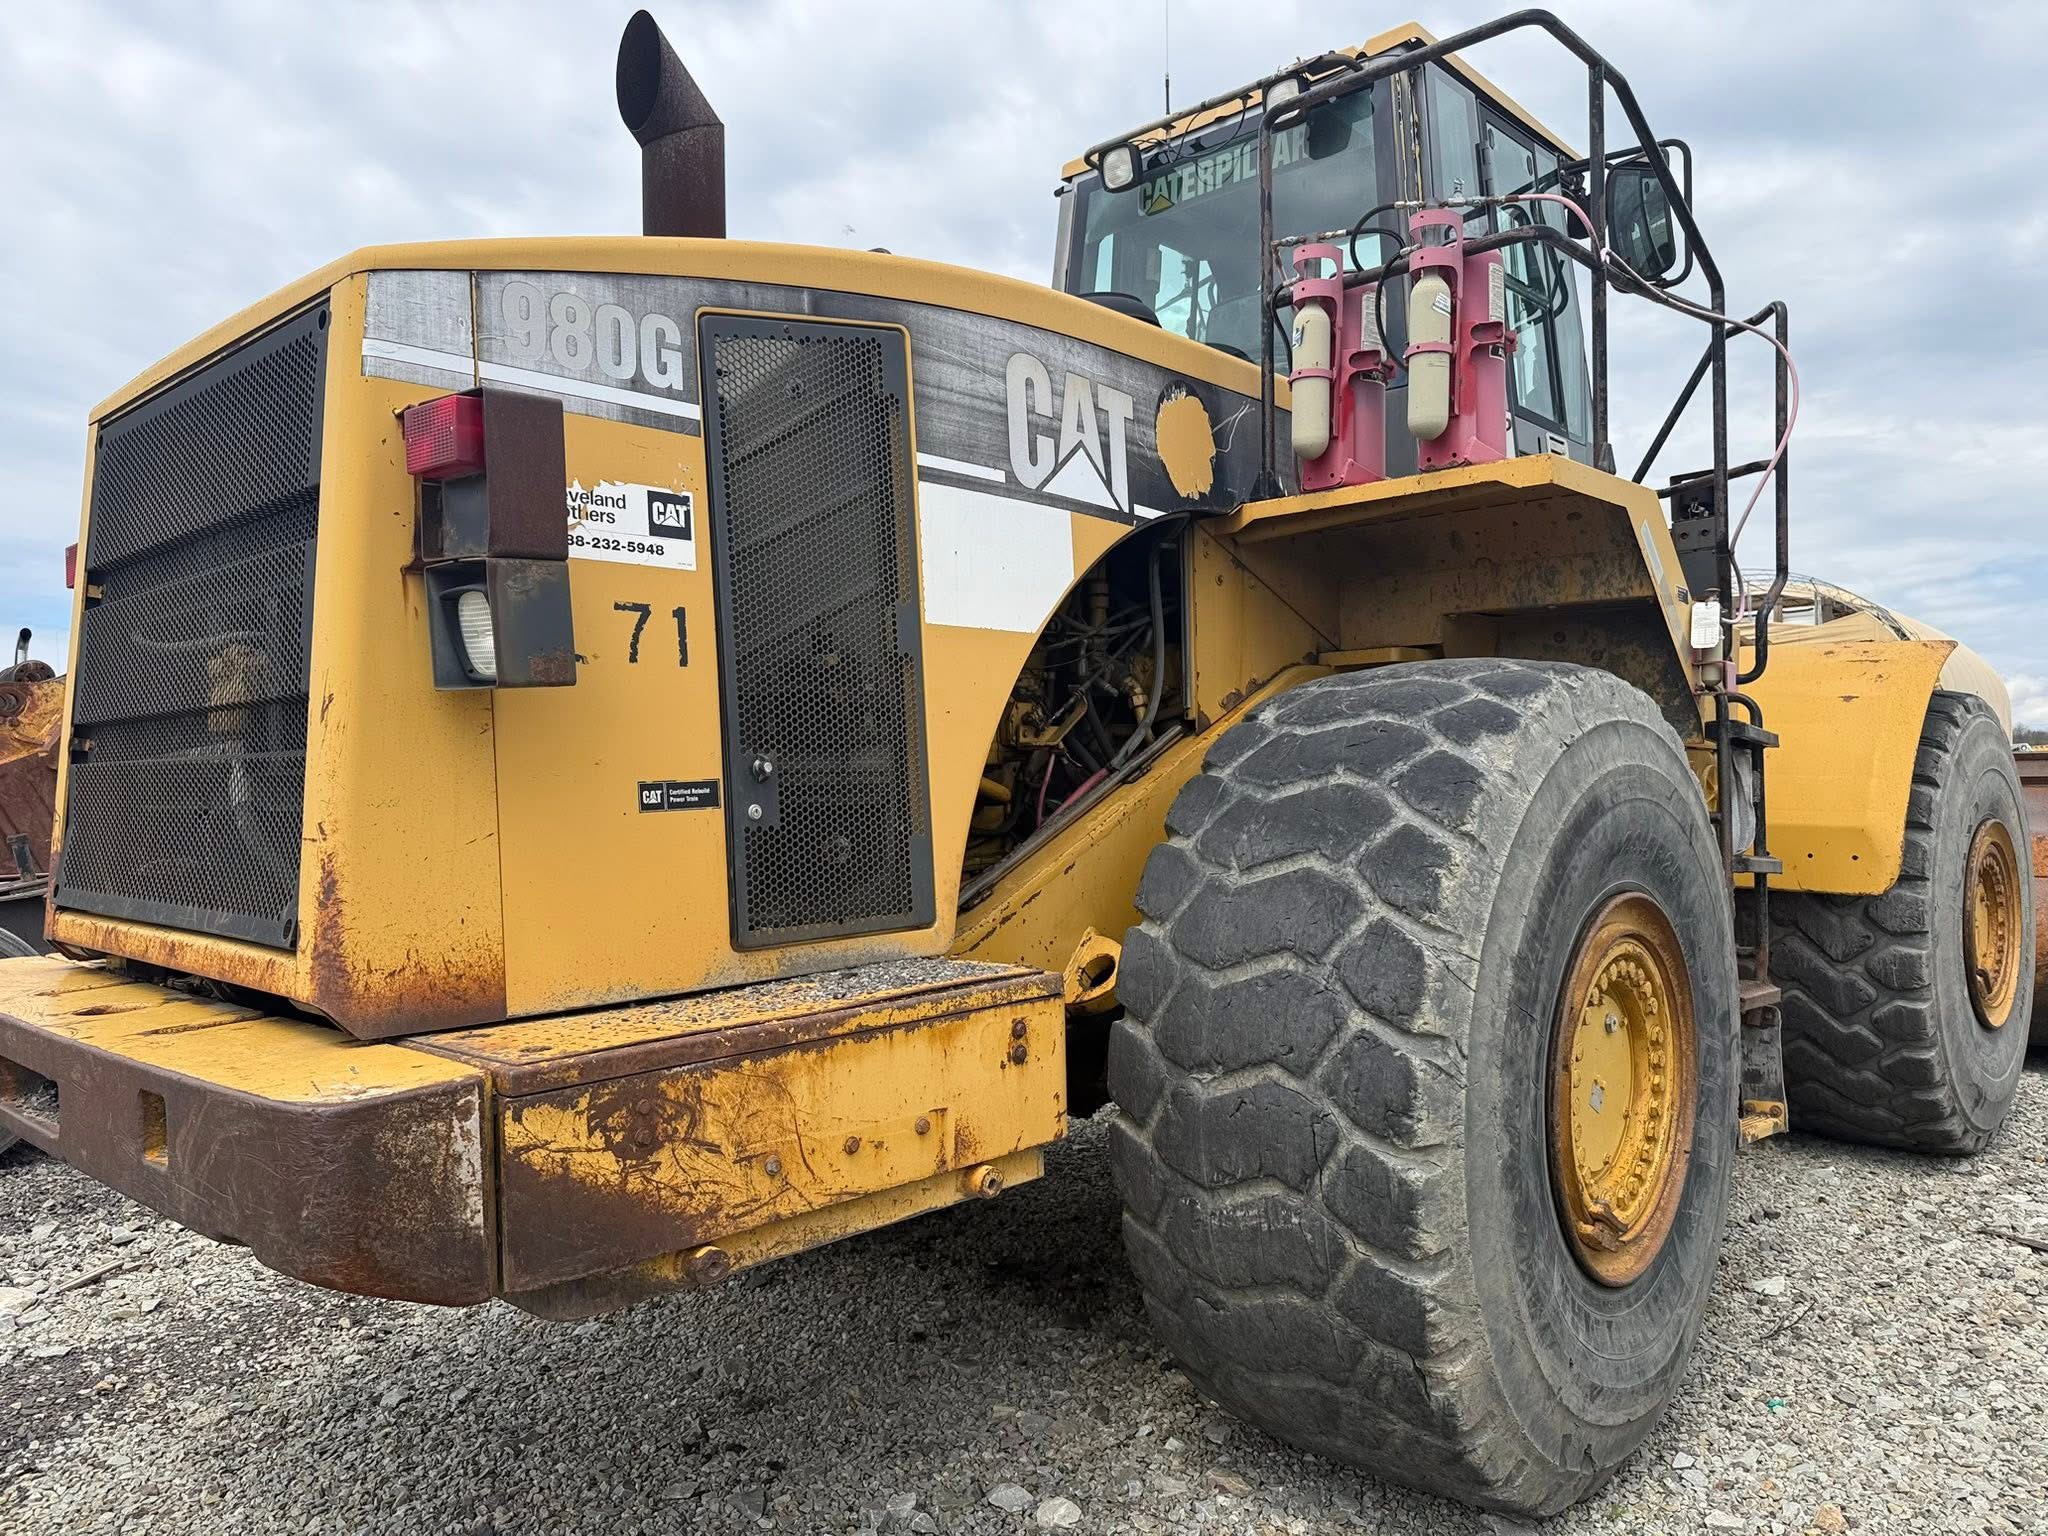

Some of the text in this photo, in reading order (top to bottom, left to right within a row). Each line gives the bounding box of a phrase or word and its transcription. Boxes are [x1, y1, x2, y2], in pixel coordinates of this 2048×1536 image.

[1138, 123, 1311, 216] CATERPILAR
[501, 281, 685, 391] 980G
[1005, 352, 1134, 514] CAT
[566, 489, 627, 509] veland
[566, 504, 616, 524] thers
[652, 501, 688, 528] CAT
[642, 790, 662, 804] CAT
